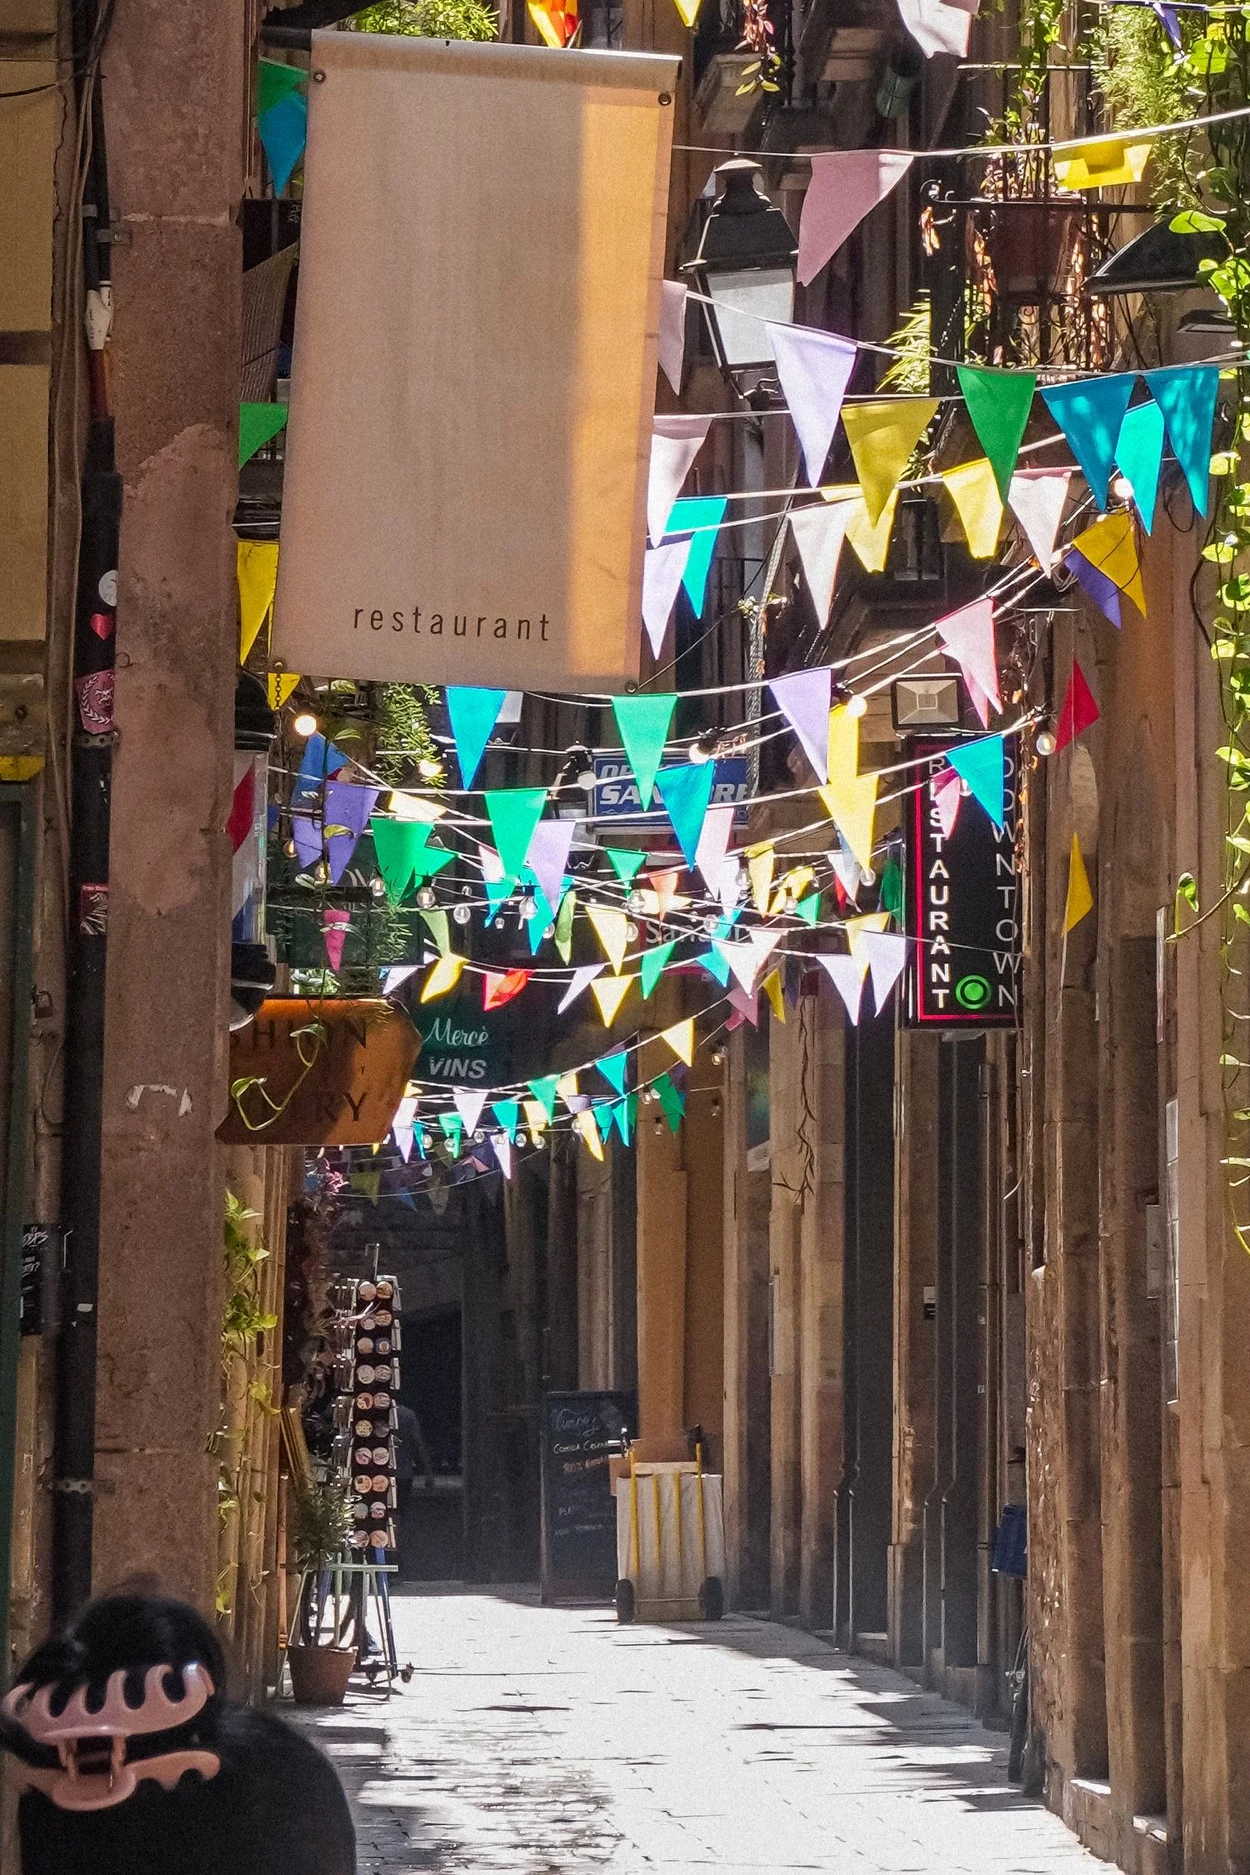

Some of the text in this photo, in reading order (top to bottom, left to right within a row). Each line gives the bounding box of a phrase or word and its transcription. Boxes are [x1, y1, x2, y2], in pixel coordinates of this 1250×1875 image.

[353, 606, 550, 642] restaurant
[424, 1017, 490, 1047] Mercè
[428, 1055, 488, 1079] VINS
